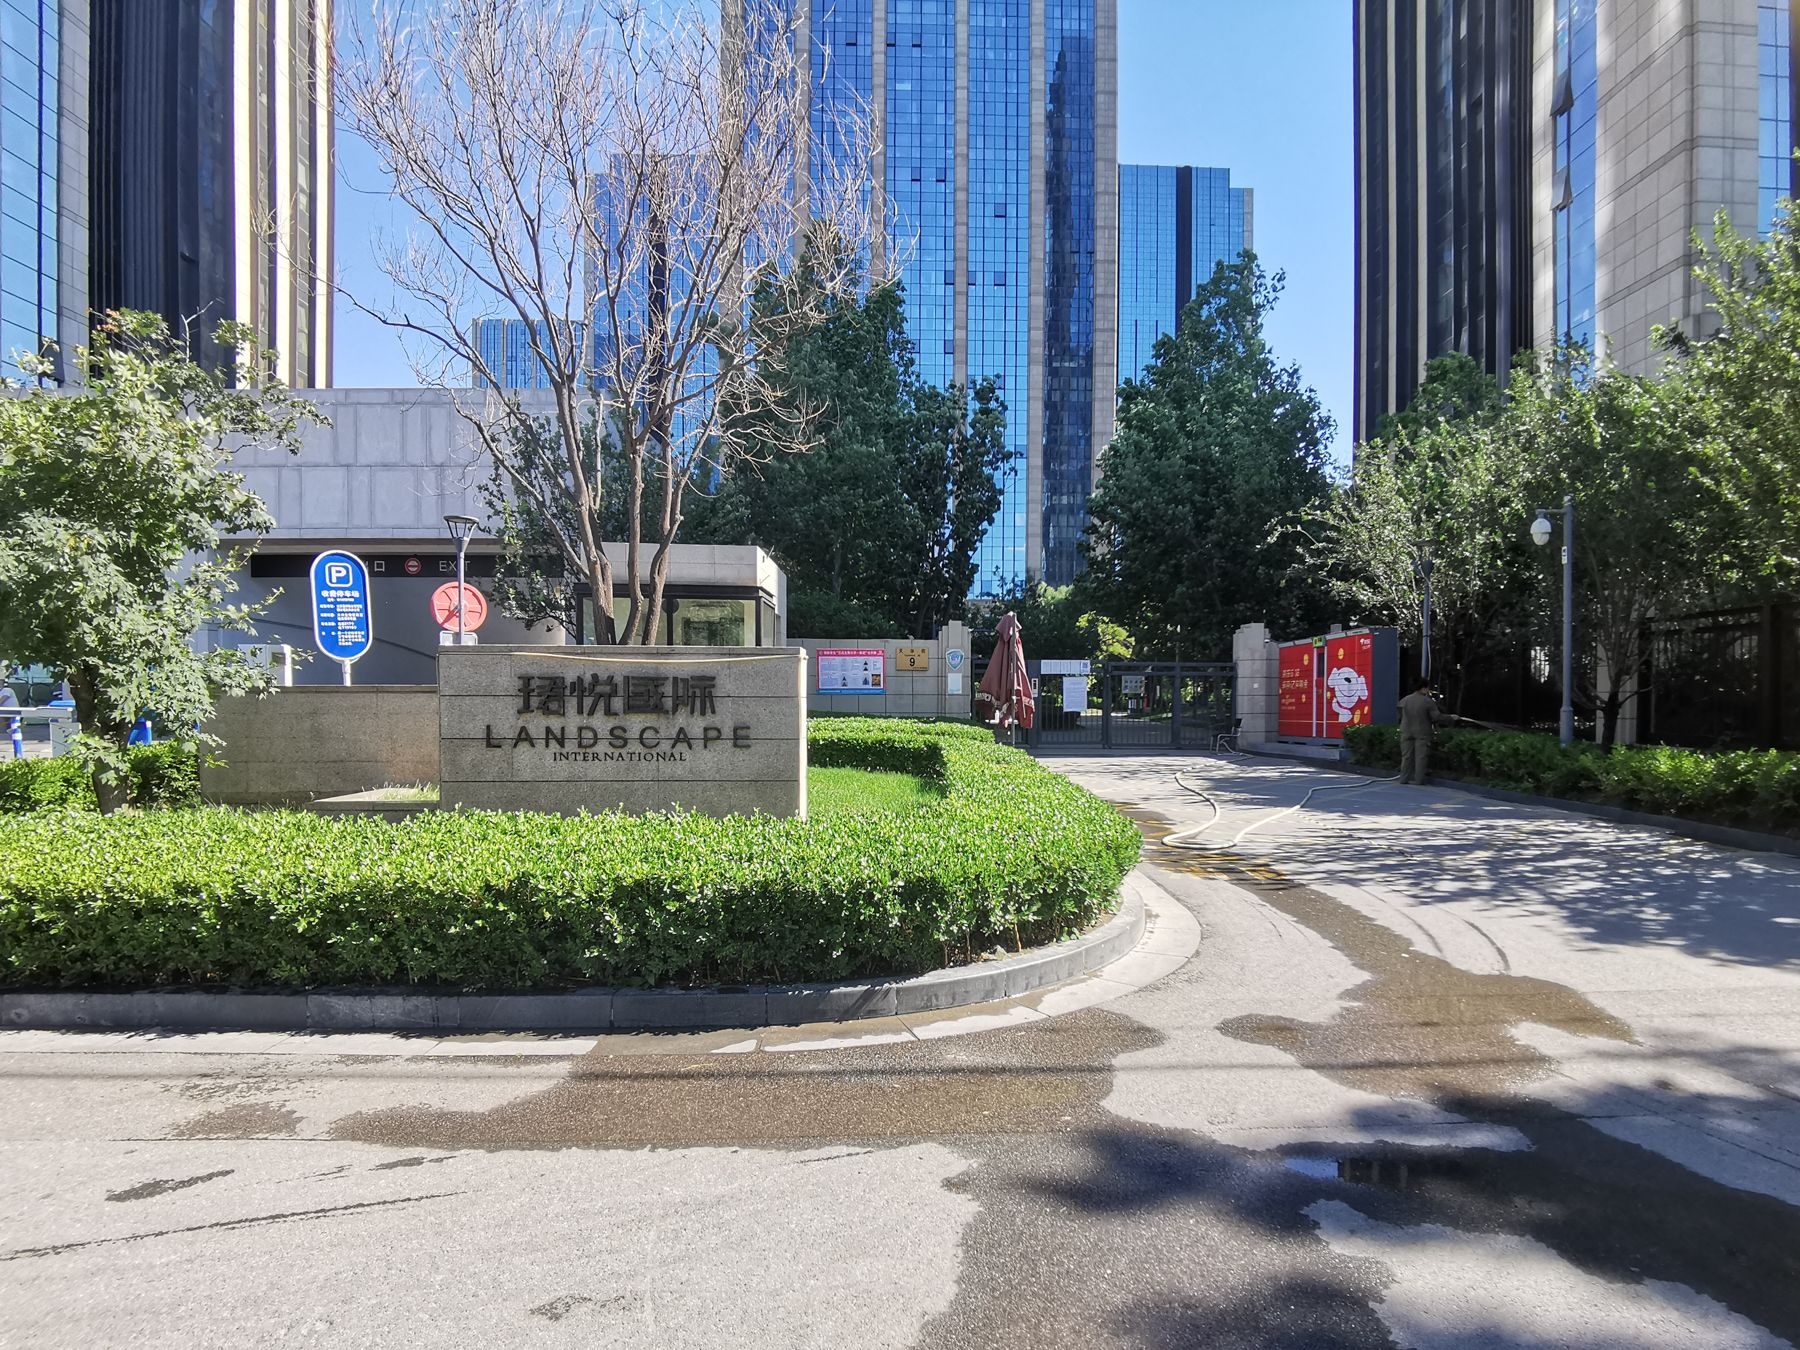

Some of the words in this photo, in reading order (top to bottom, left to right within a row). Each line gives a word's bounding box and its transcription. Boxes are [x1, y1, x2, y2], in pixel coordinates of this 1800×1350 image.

[440, 560, 471, 572] EXT
[331, 566, 346, 583] P
[909, 657, 916, 667] 9
[485, 725, 751, 750] LANDSCAPE
[553, 751, 687, 762] INTERNATIONAL
